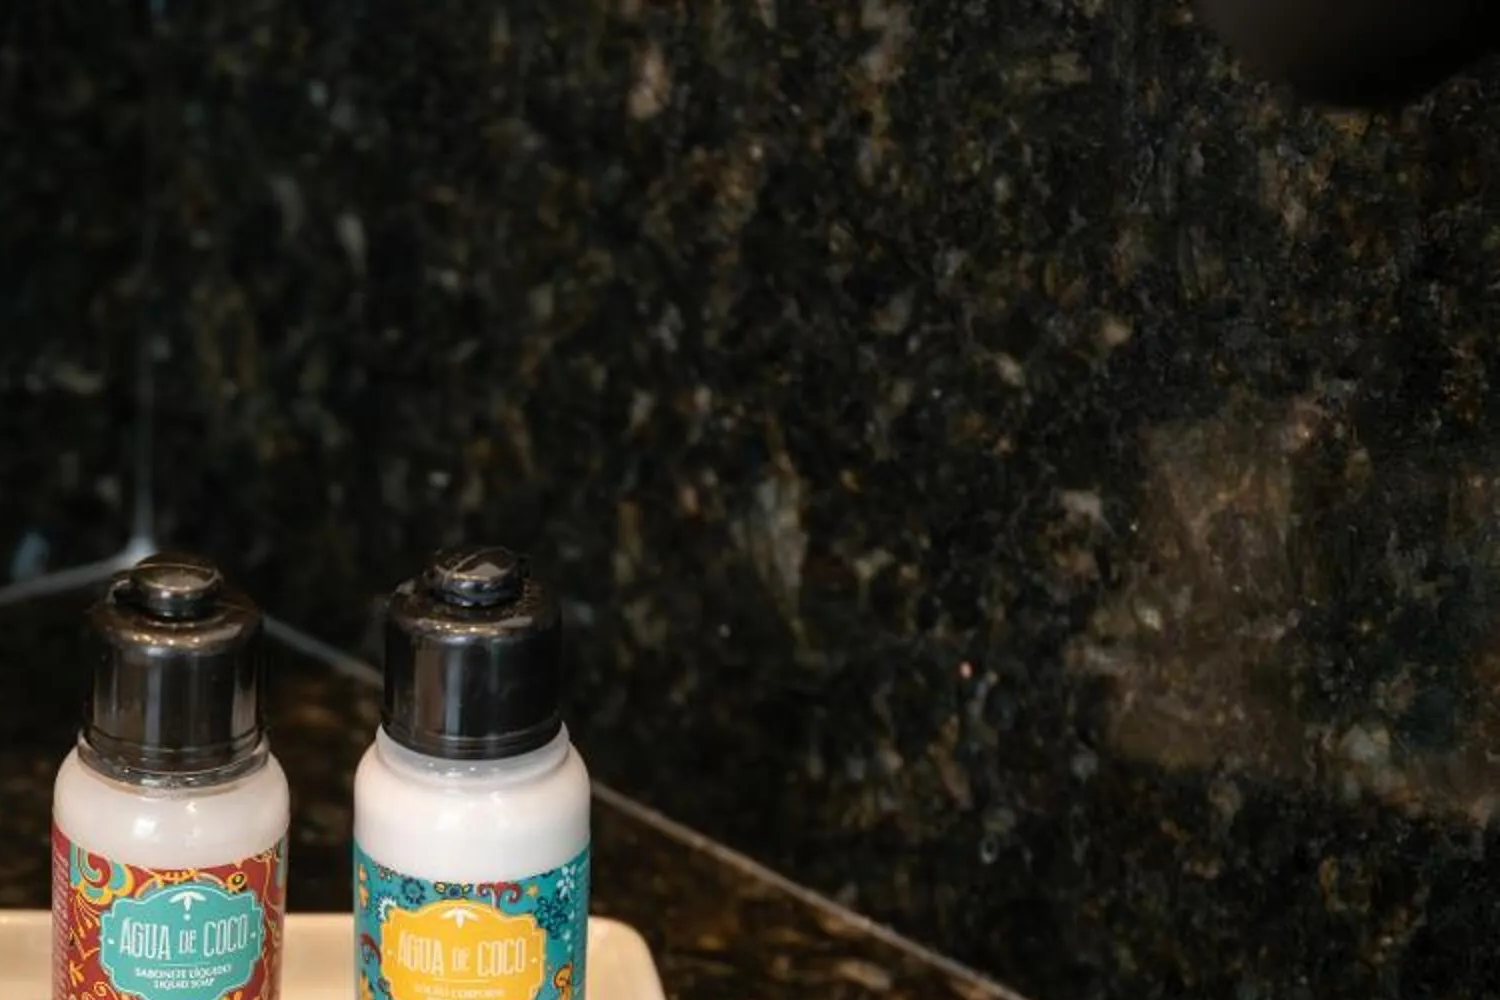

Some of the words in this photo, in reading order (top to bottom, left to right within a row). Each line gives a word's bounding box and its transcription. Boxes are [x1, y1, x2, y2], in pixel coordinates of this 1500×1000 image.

[119, 916, 172, 961] ÁGUA
[178, 929, 197, 954] DE
[203, 913, 249, 957] COCO
[451, 946, 470, 973] DE
[476, 936, 527, 978] COCO
